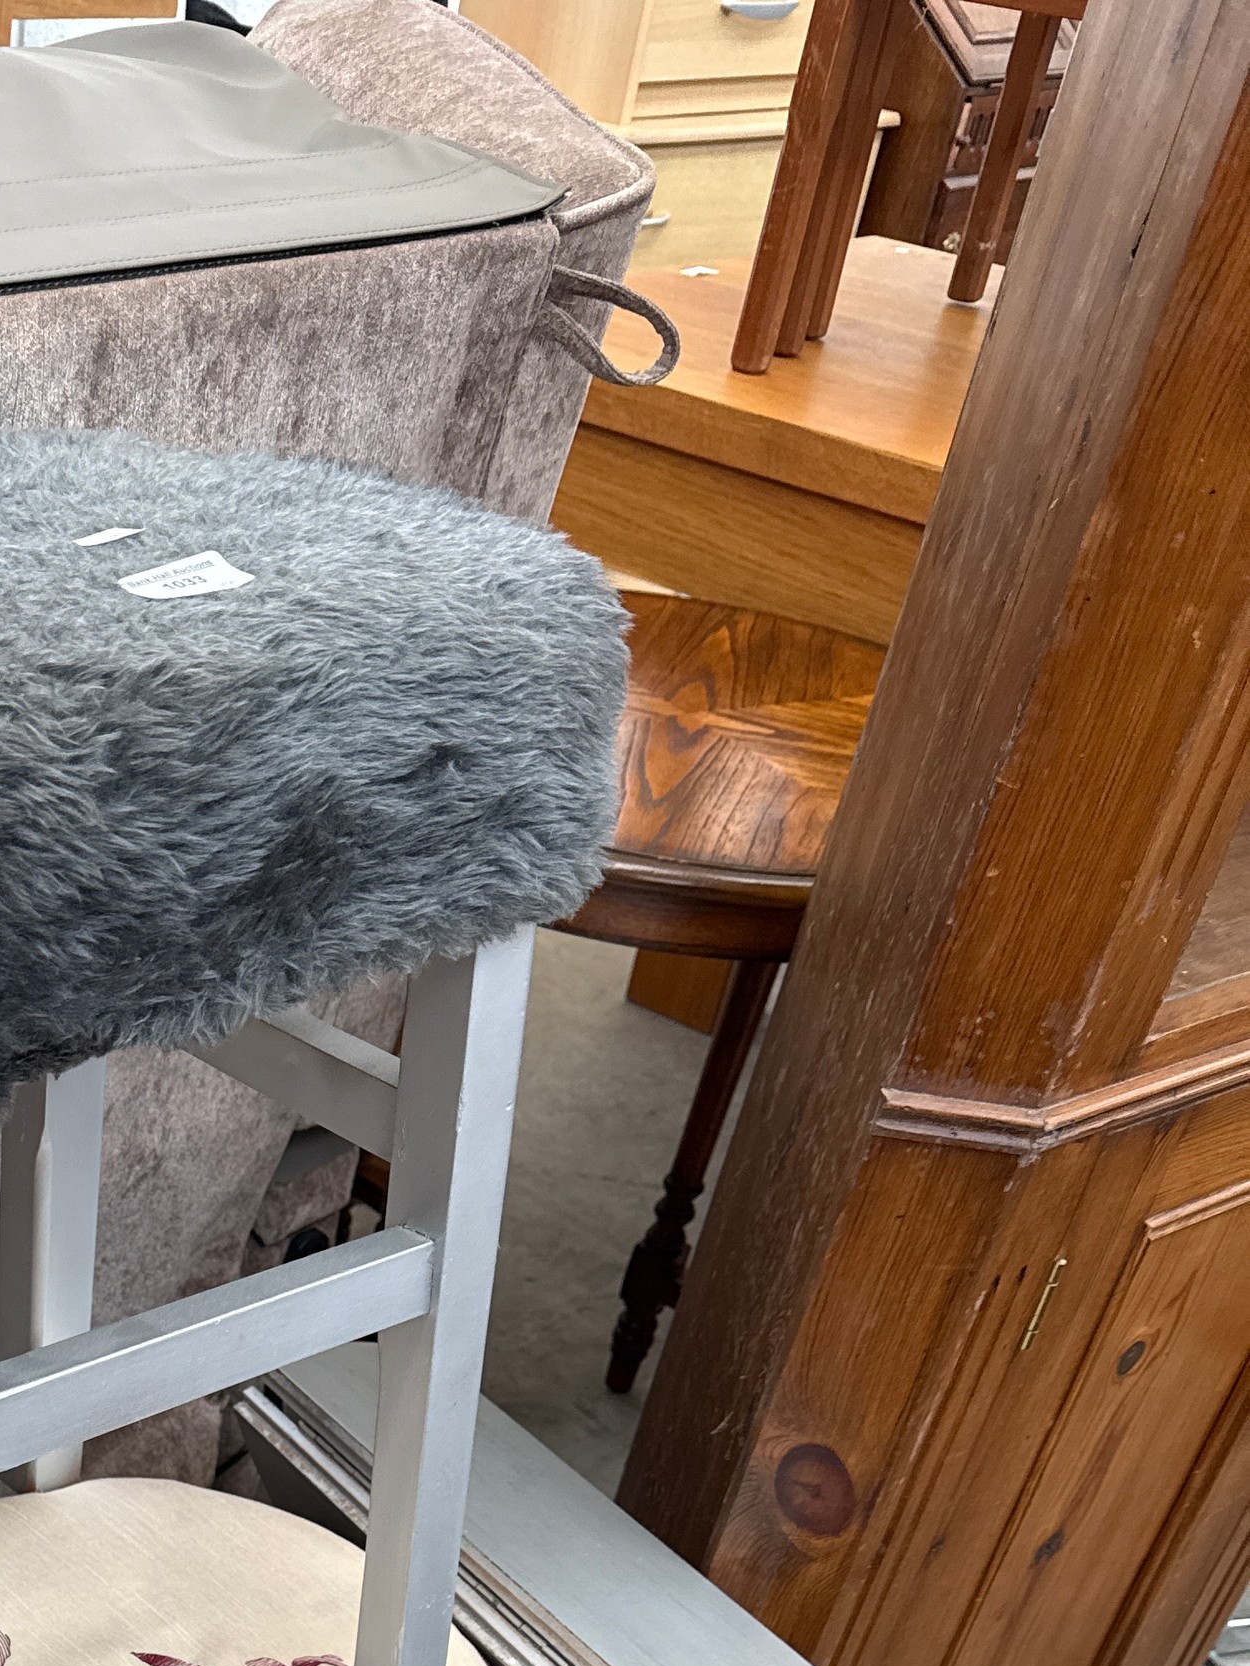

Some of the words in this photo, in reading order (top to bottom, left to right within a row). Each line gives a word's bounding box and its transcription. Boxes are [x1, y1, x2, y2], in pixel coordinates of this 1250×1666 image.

[127, 577, 152, 588] Bank
[153, 571, 170, 581] Hall
[173, 560, 215, 576] Auctions
[162, 575, 208, 590] 1033
